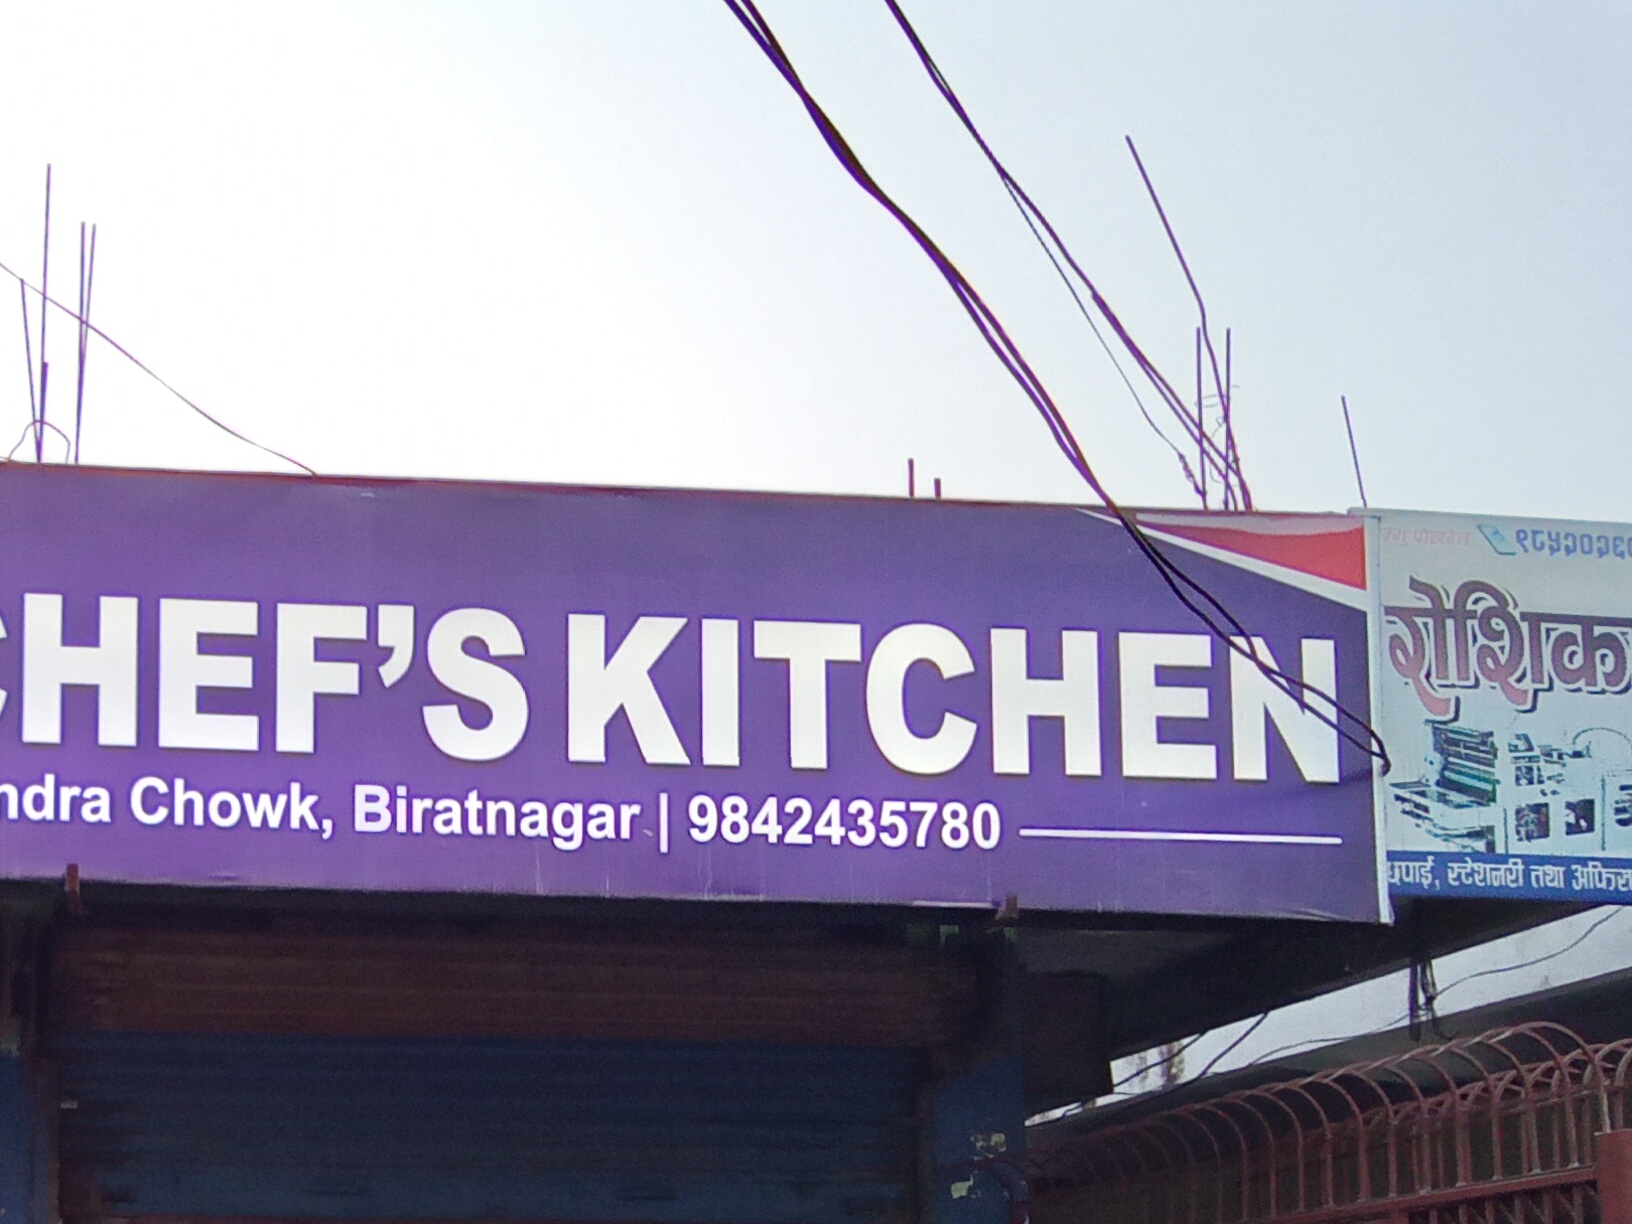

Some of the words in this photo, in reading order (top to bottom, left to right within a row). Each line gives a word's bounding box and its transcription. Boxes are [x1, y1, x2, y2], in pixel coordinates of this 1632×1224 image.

[567, 612, 1342, 783] KITCHEN
[130, 776, 334, 840] Chowk,
[354, 783, 642, 851] Biratnagar
[688, 794, 1002, 850] 9842435780
[1529, 865, 1566, 889] तथा
